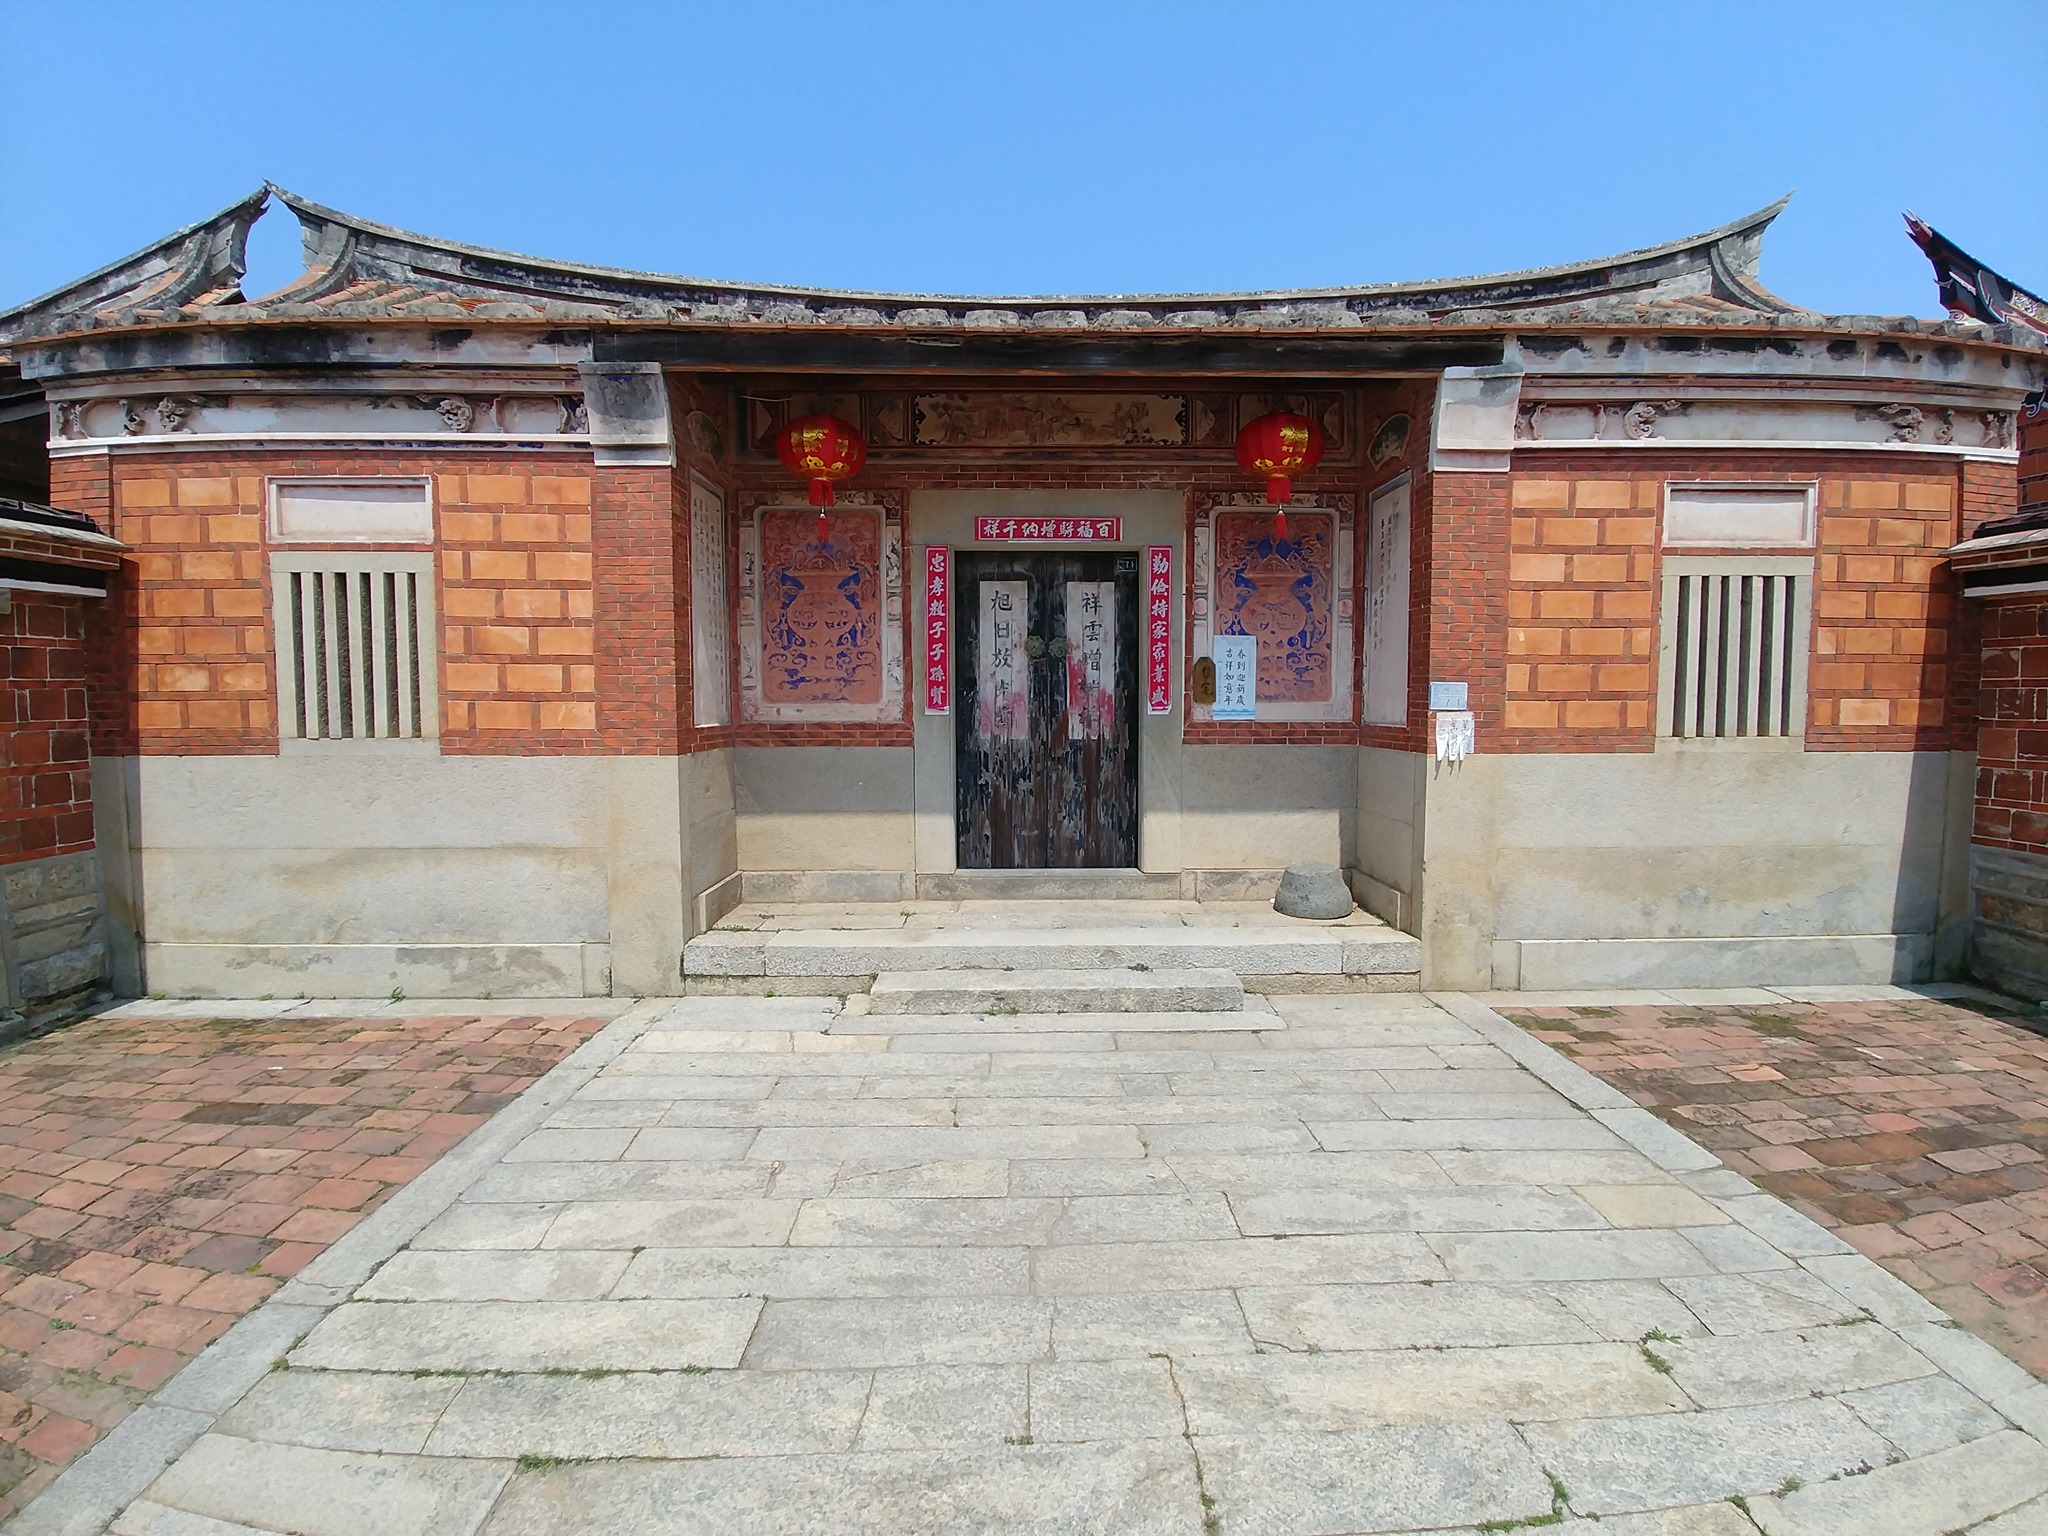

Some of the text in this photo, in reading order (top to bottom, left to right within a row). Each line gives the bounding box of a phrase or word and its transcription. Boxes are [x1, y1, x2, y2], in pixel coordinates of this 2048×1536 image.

[929, 552, 946, 705] 忠孝教子子孫賢
[1151, 552, 1169, 705] 勤儉持家家業盛
[1224, 647, 1234, 706] 吉祥如意年
